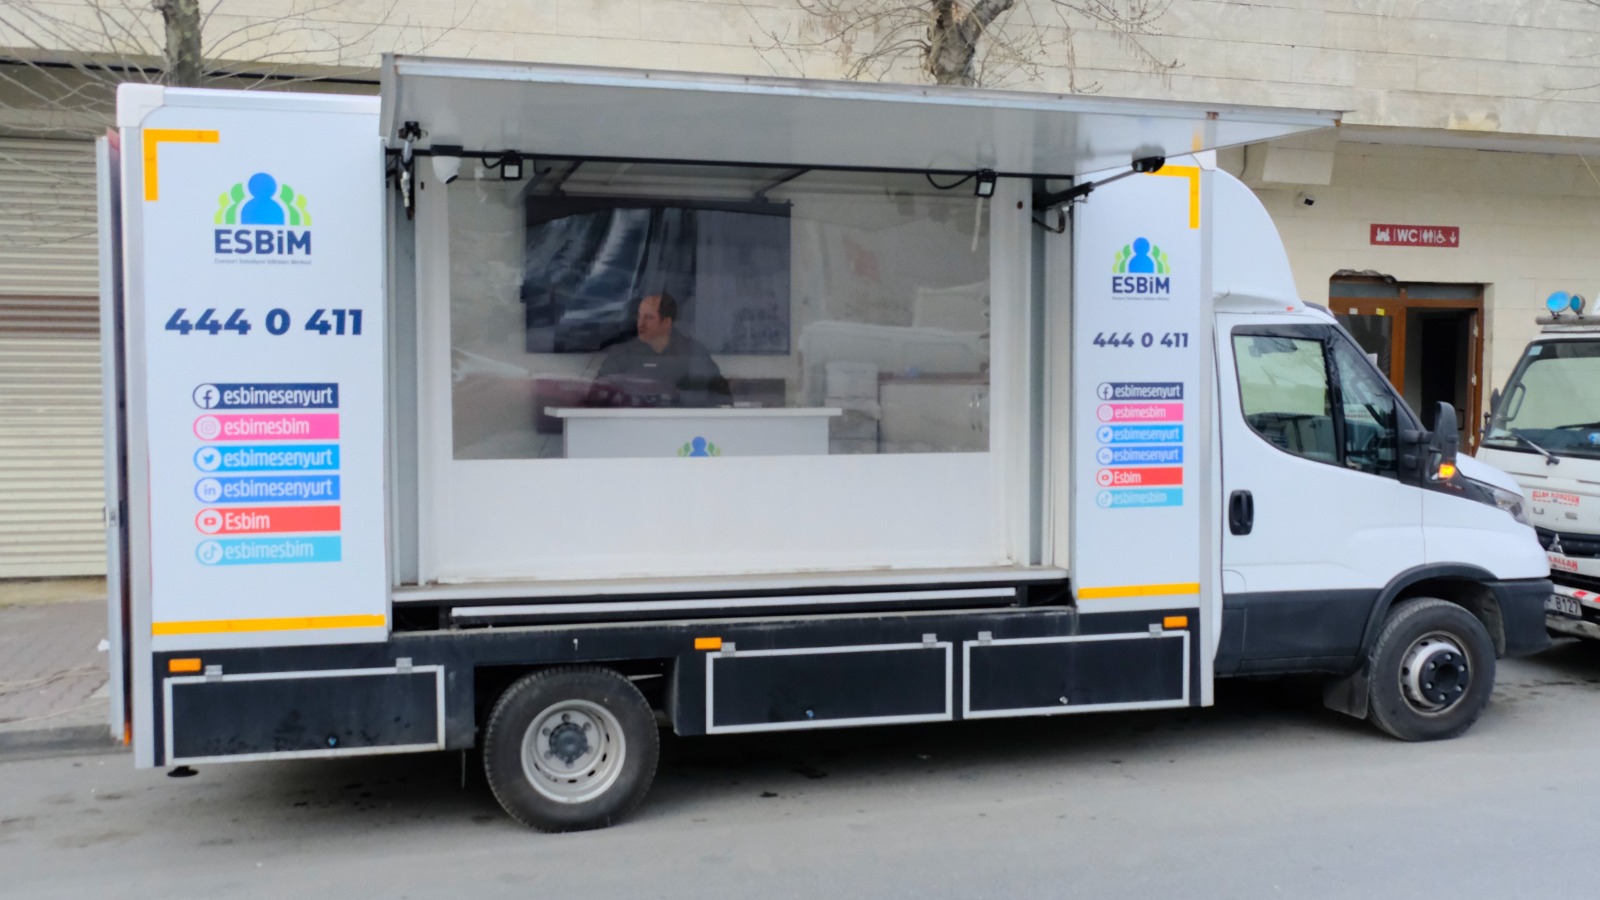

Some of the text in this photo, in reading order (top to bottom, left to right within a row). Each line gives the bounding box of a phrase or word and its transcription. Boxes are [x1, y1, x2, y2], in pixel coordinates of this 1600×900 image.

[1397, 229, 1418, 243] WC
[165, 308, 363, 336] 444 0 411
[1093, 332, 1189, 348] 444 0 411
[223, 386, 333, 406] esbimesenyurt
[1115, 385, 1180, 398] esbimesenyurt
[1115, 407, 1166, 418] esbimesbim
[224, 417, 310, 435] esbimesbim
[1114, 427, 1180, 441] esbimesenyurt
[223, 448, 333, 468] esbimesenyurt
[1114, 448, 1179, 463] esbimesenyurt
[1114, 471, 1142, 484] Esbim
[224, 479, 333, 498] esbimesenyurt
[225, 512, 270, 530] Esbim
[225, 540, 314, 559] esbimesbim
